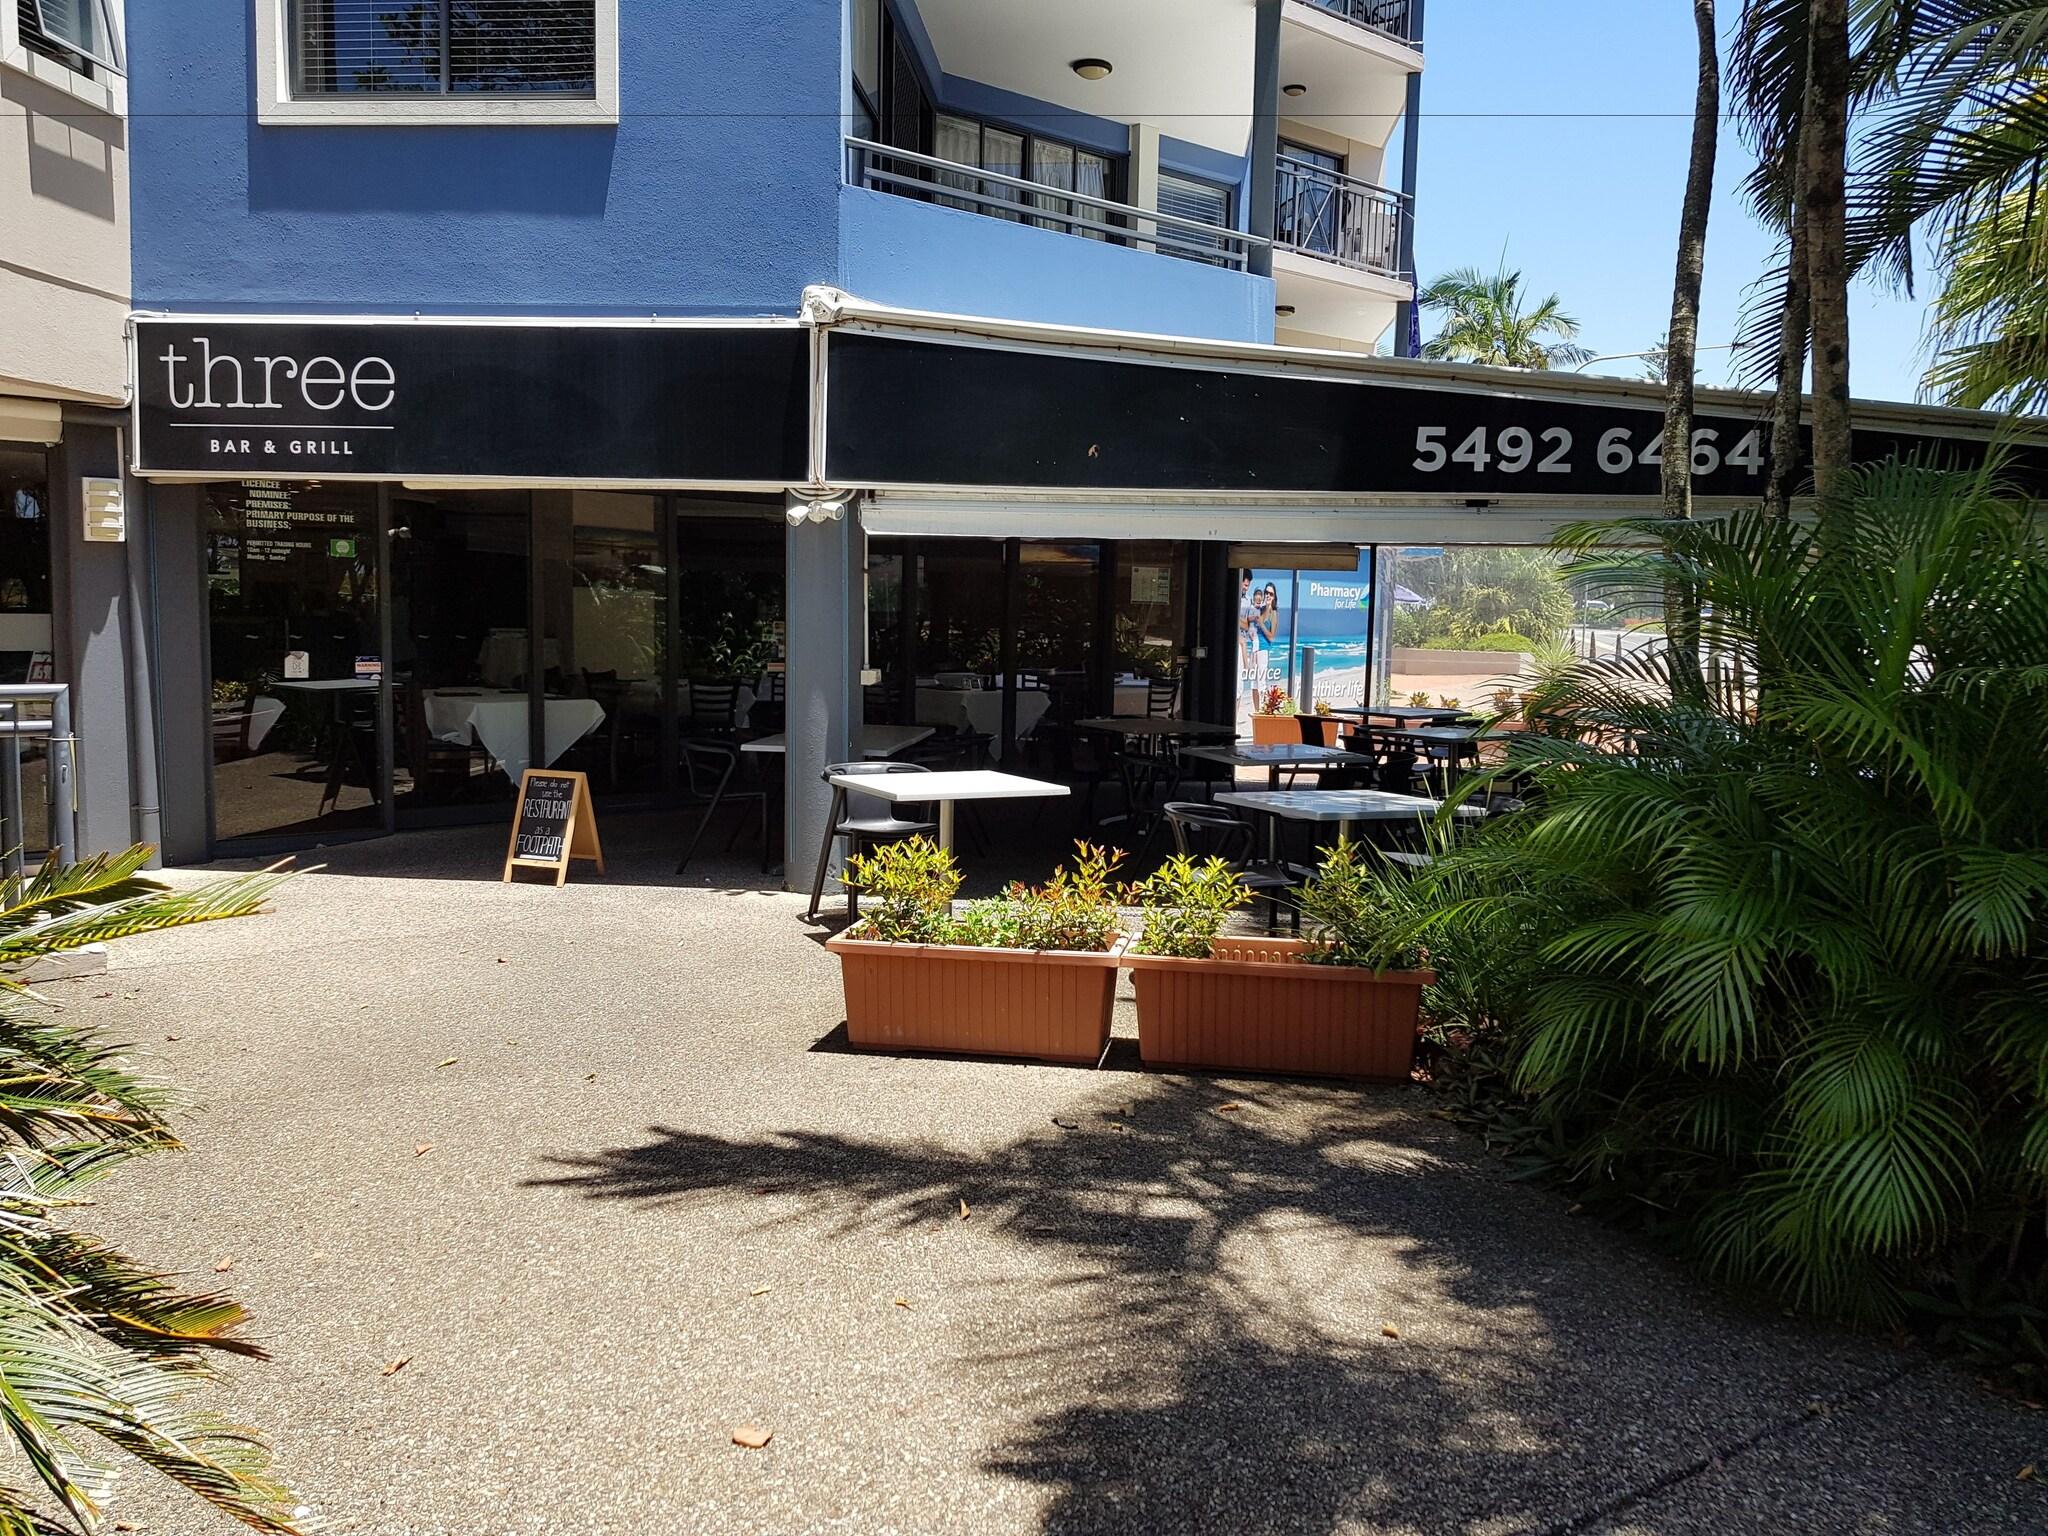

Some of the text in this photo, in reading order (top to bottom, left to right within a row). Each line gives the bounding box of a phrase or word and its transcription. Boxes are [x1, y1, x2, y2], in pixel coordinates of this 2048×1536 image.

[159, 337, 396, 411] three
[210, 439, 354, 456] BAR & GRILL
[1412, 426, 1573, 473] 5492
[246, 509, 355, 524] PRIMARY PURPOSE OF THE
[1310, 582, 1361, 600] Pharmacy
[1334, 598, 1357, 610] for Life
[1241, 664, 1281, 681] advice
[1295, 680, 1364, 700] halthier life
[530, 777, 548, 788] Please
[550, 779, 558, 788] do
[534, 826, 551, 835] as a
[516, 834, 565, 855] FOOTPATH
